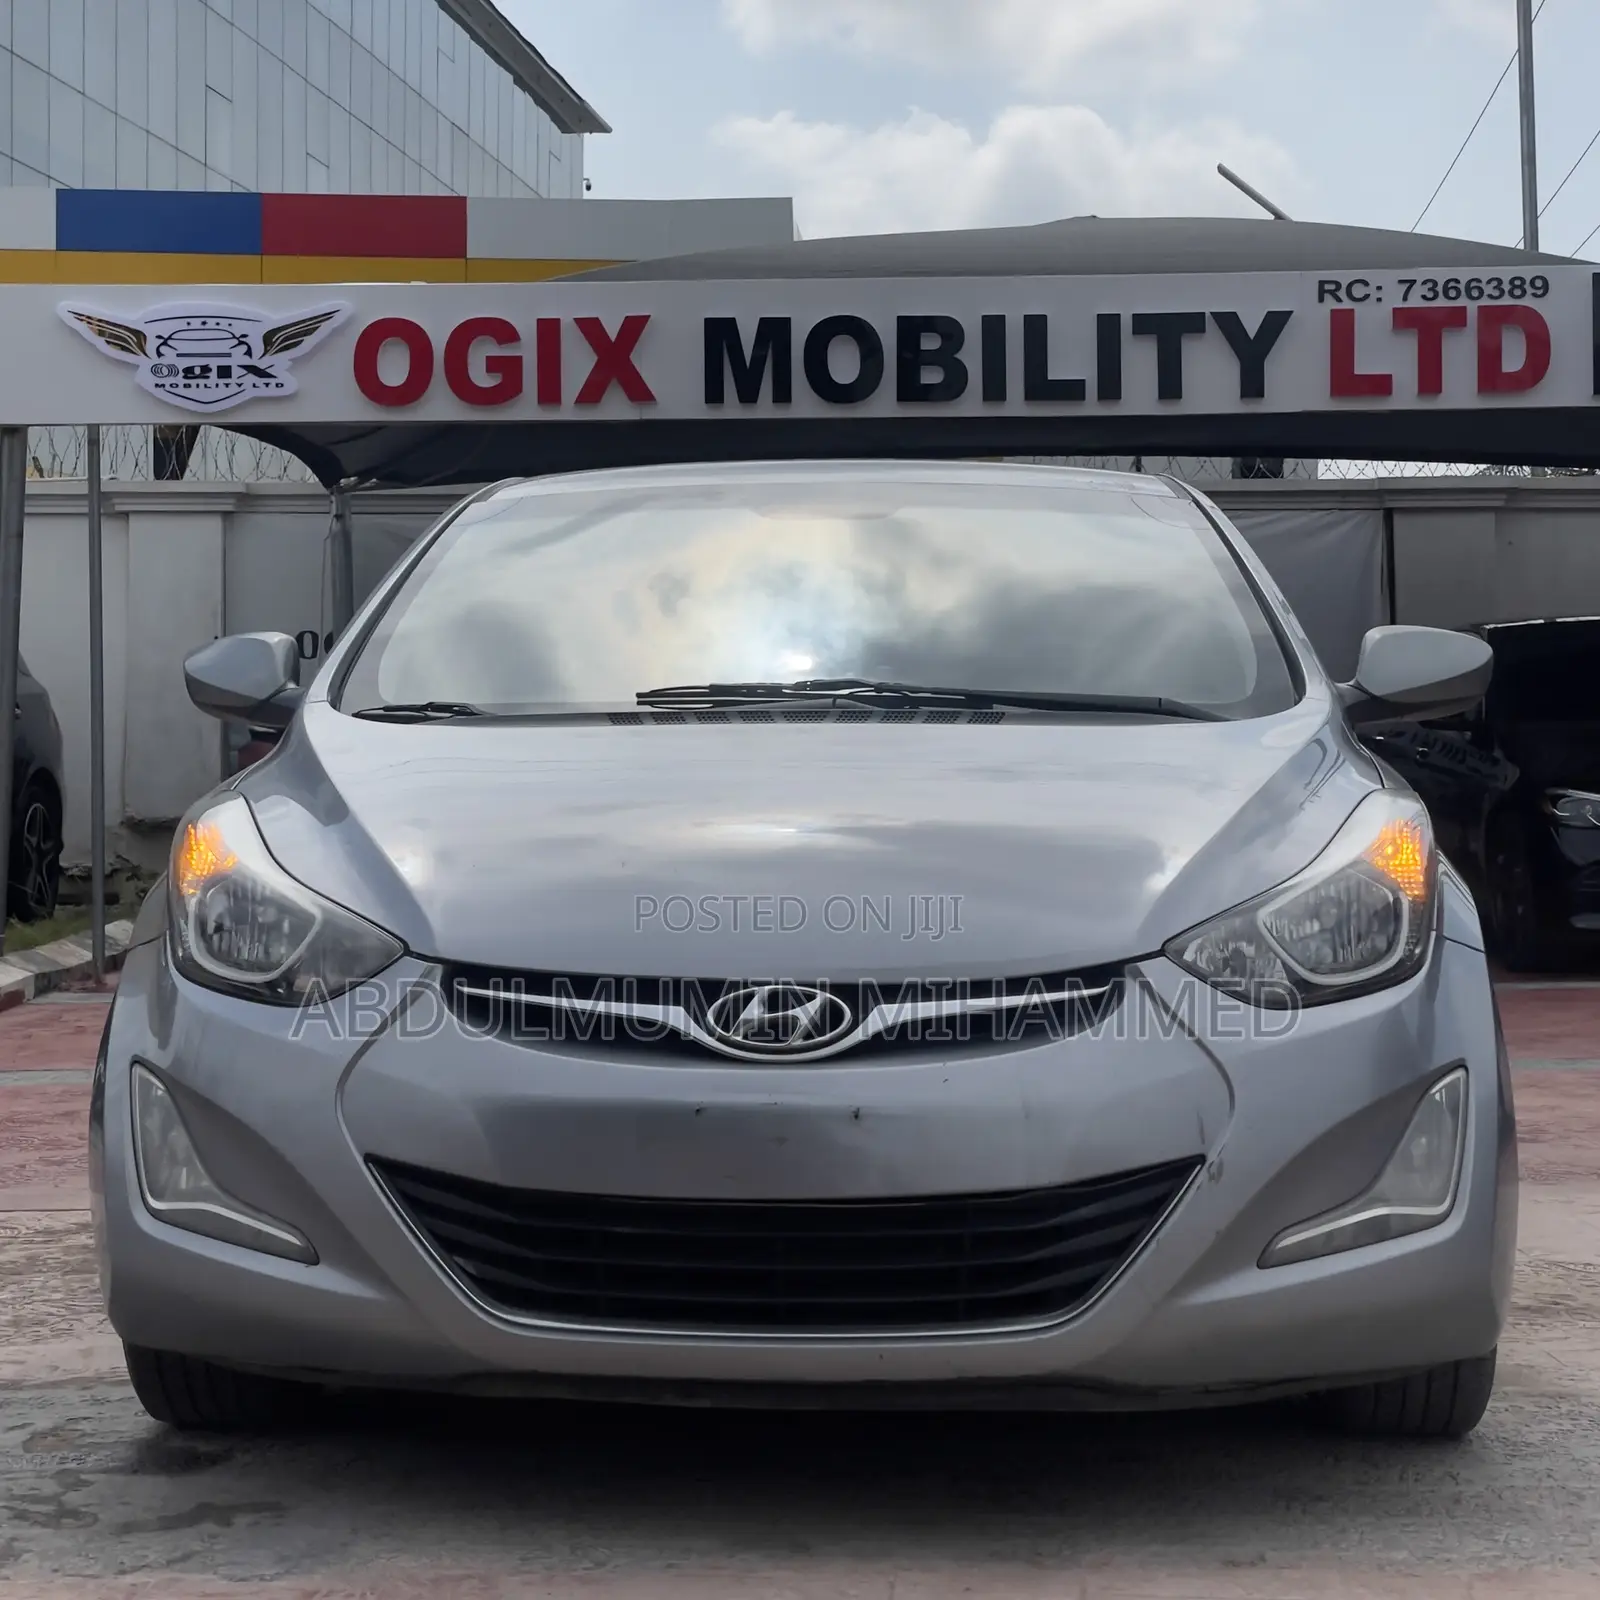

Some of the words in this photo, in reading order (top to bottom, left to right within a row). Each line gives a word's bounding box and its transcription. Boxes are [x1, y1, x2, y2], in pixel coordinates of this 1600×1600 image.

[1317, 278, 1383, 303] RC:
[1397, 274, 1550, 302] 7366389
[353, 313, 658, 407] OGIX
[703, 309, 1295, 405] MOBILITY
[1329, 304, 1552, 397] LTD
